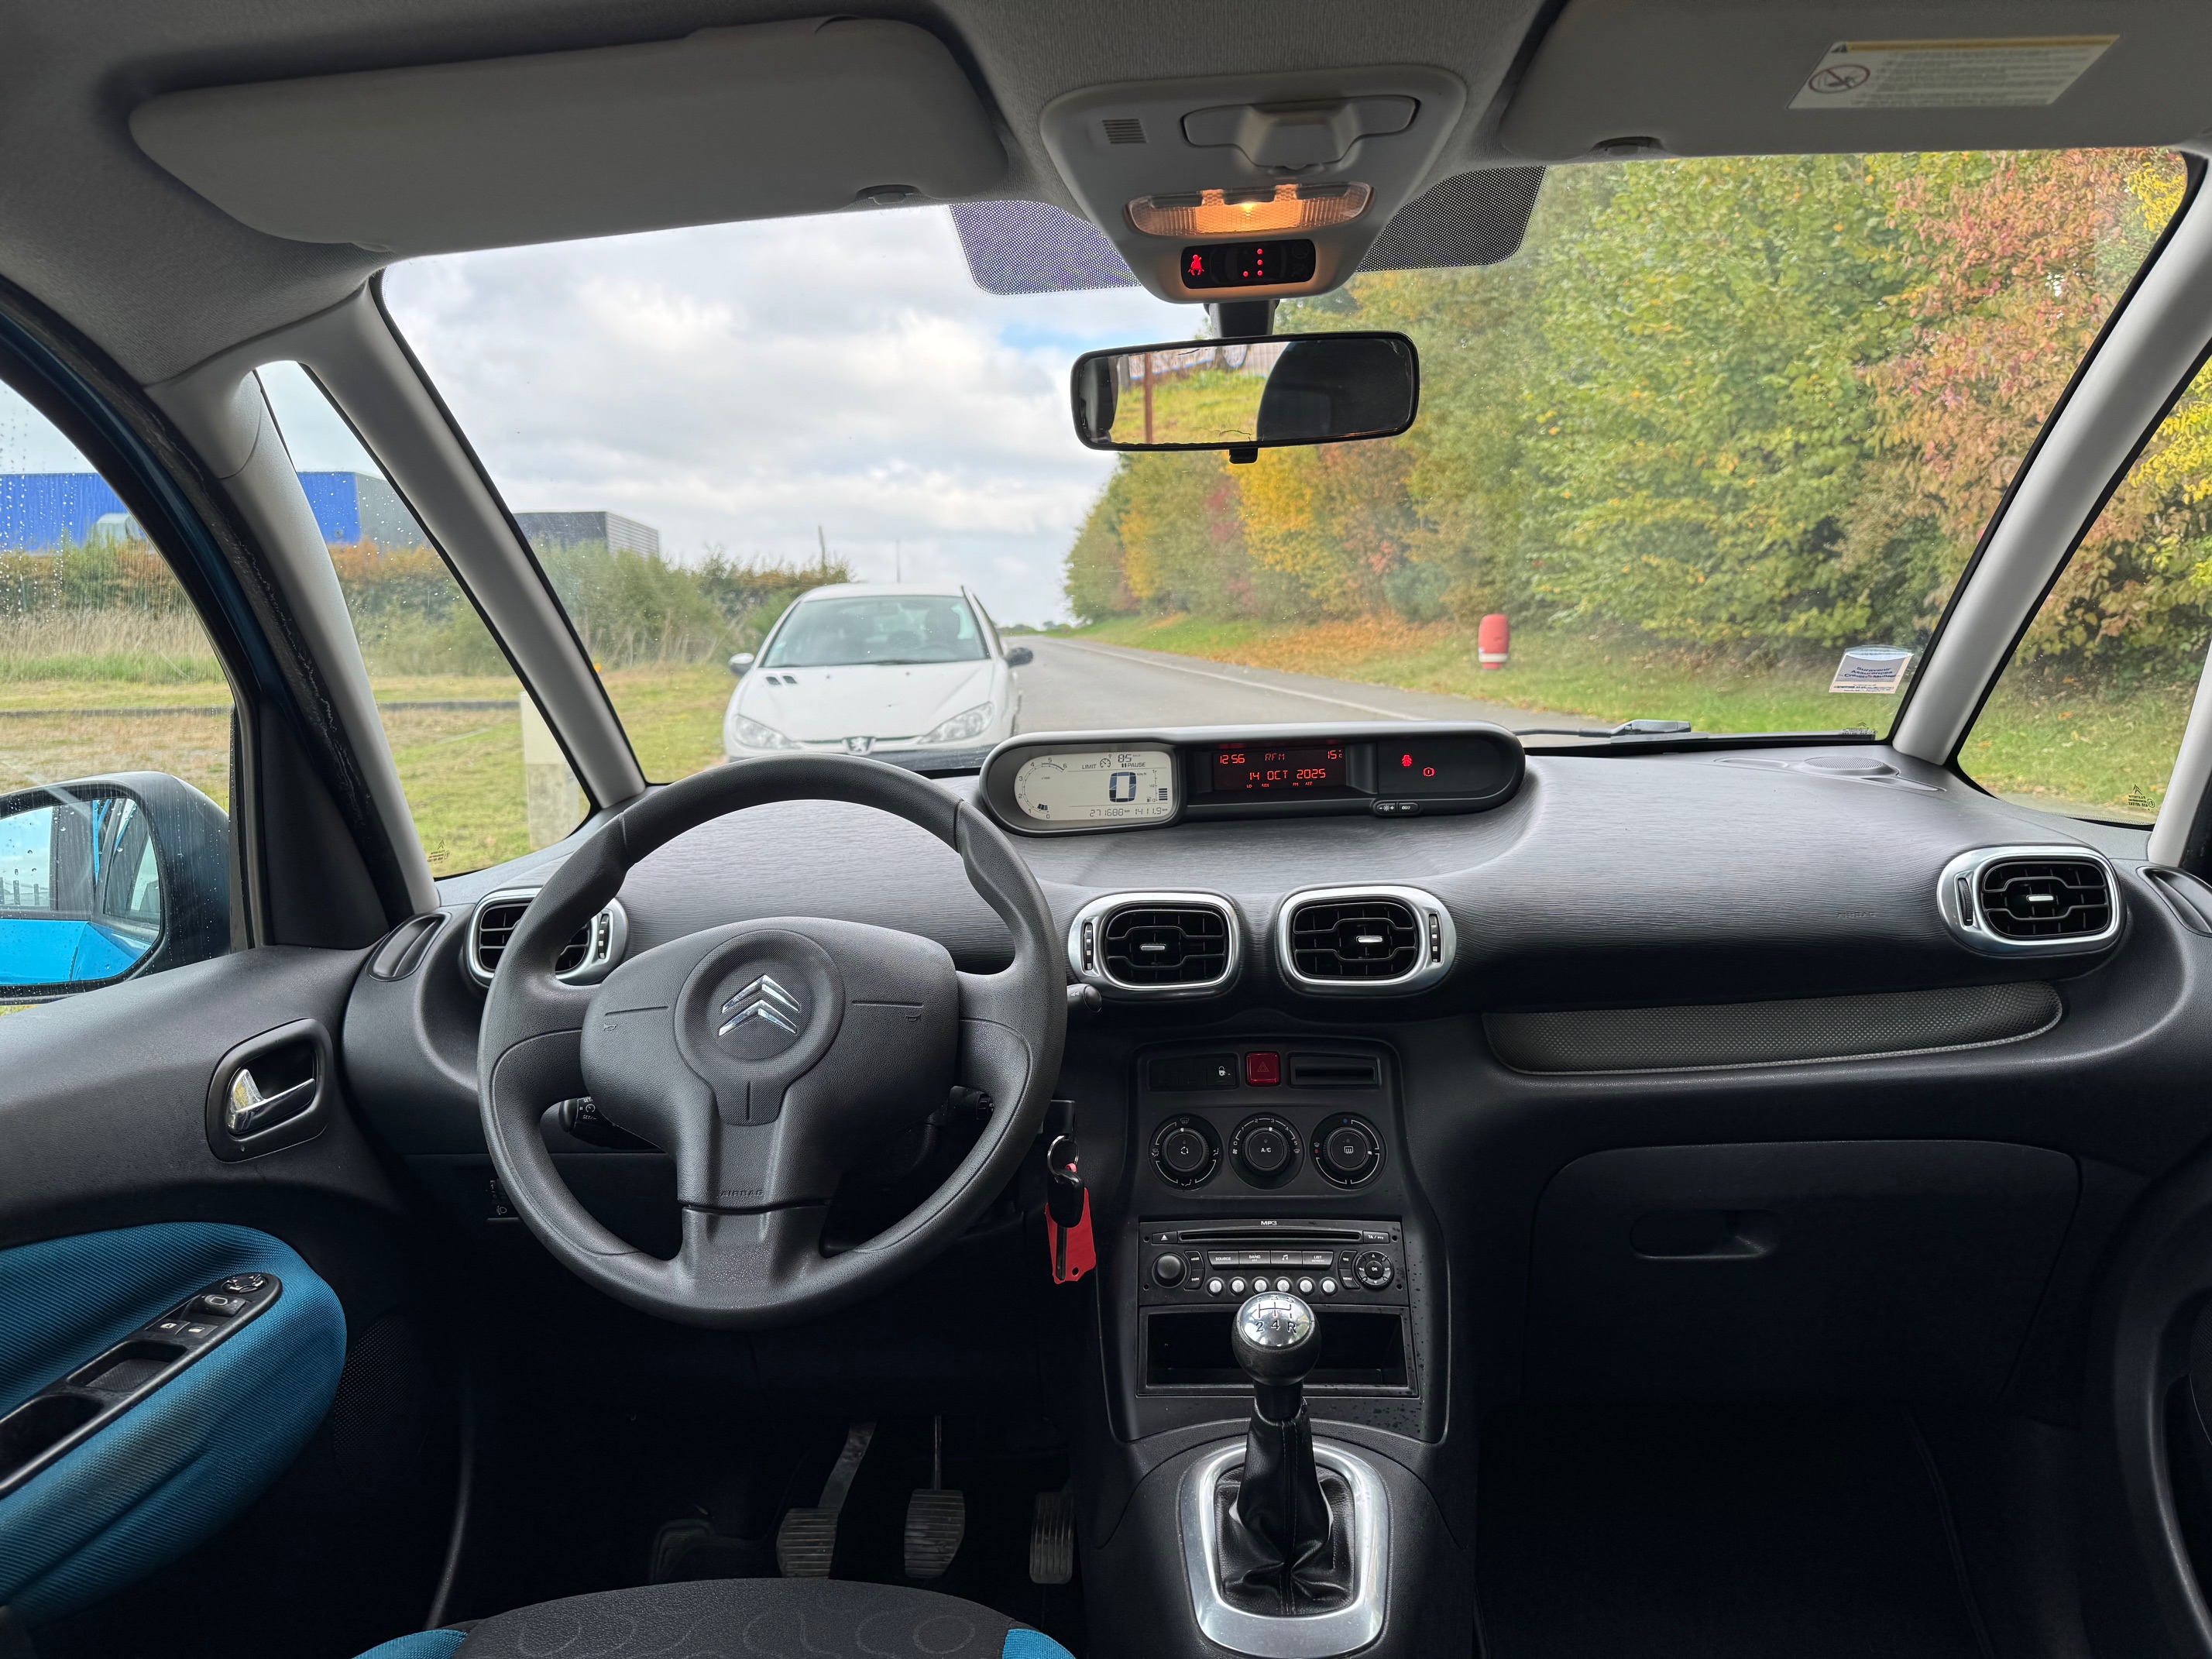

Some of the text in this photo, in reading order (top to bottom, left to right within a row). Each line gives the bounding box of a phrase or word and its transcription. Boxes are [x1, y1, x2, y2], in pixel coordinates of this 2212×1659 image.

[1118, 754, 1132, 763] 85
[1249, 768, 1326, 781] 14 OCT 2025
[1109, 771, 1137, 803] 0
[1089, 808, 1124, 817] 271688
[1255, 1320, 1297, 1334] 2 4 R
